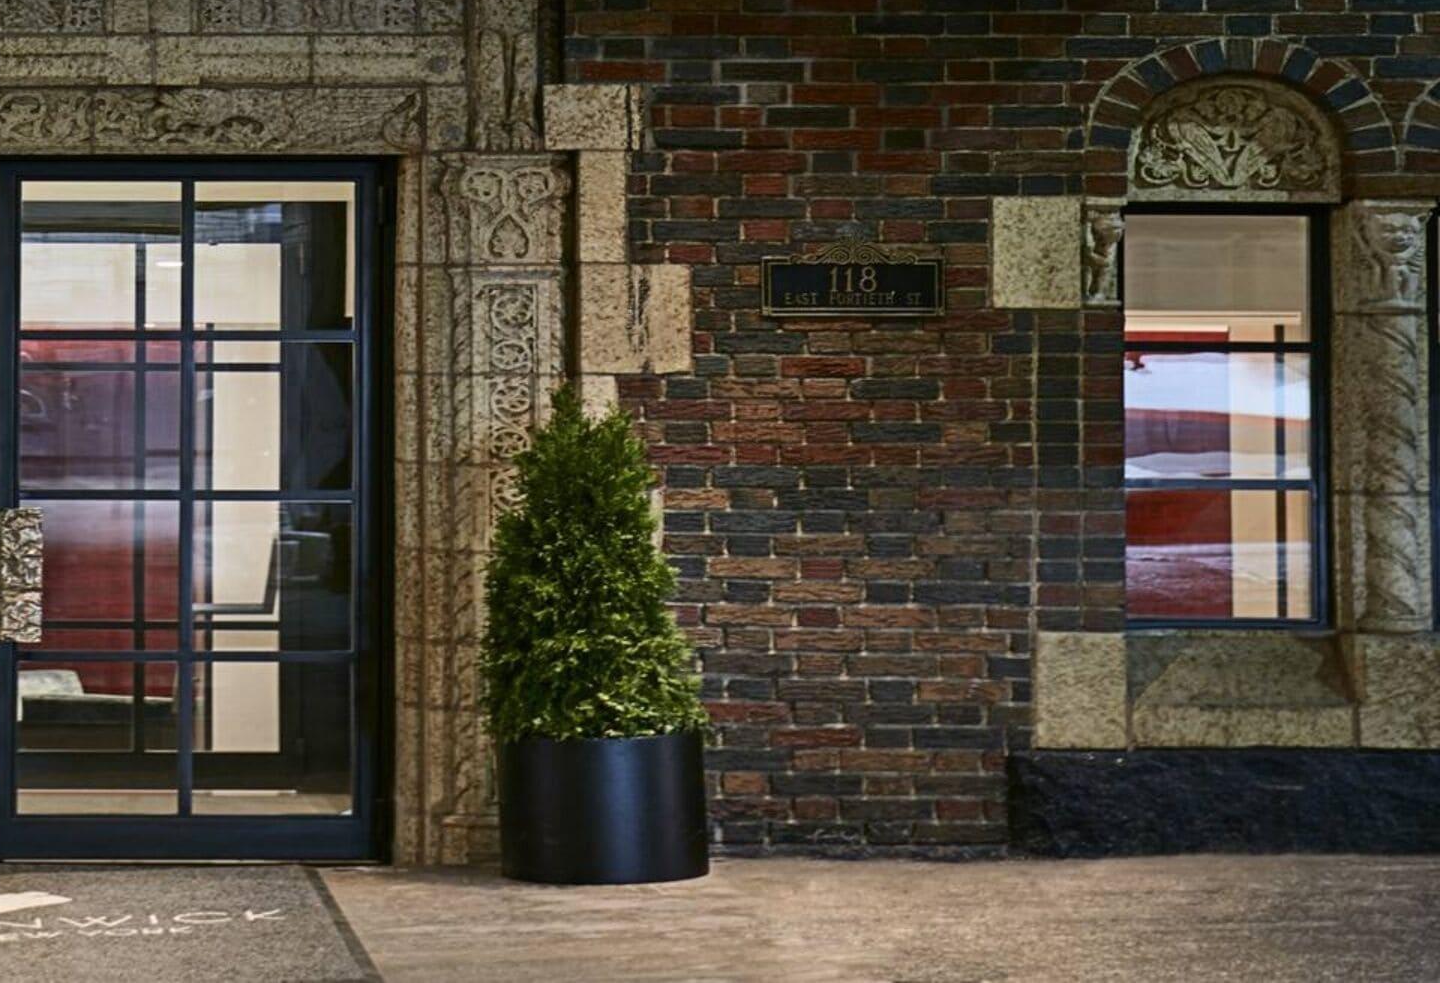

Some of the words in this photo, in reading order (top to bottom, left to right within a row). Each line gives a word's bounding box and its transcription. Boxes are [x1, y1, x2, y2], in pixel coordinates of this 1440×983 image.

[829, 267, 878, 293] 118
[784, 292, 818, 305] EAST
[77, 925, 194, 937] YORK
